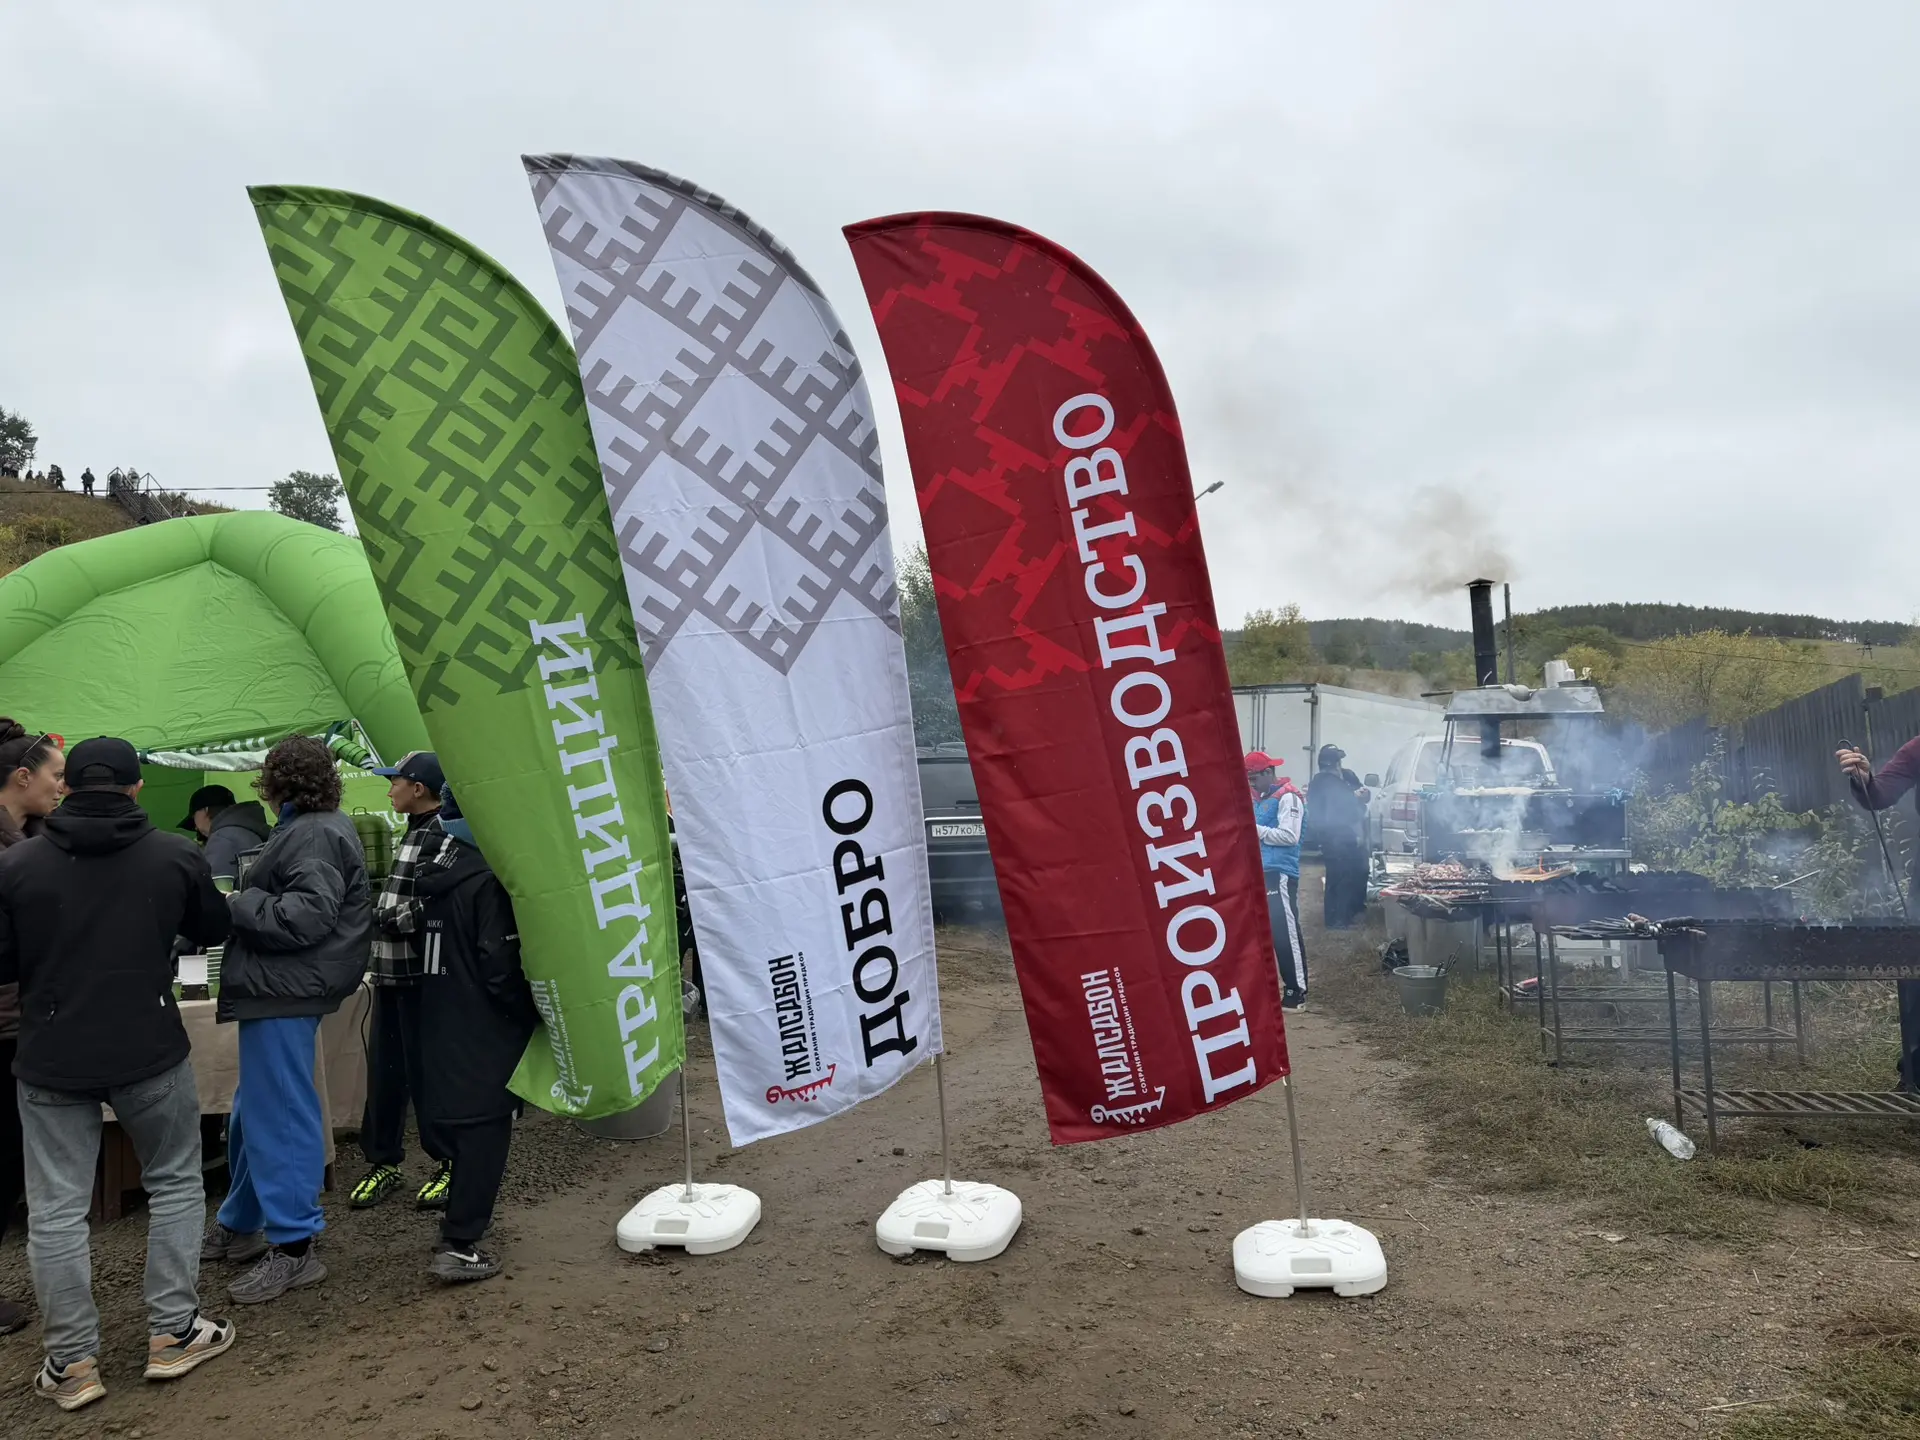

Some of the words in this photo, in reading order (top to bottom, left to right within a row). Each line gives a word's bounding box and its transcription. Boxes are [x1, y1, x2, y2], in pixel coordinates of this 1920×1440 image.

[1053, 393, 1257, 1104] ПРОИЗВОДСТВО
[529, 612, 660, 1098] ТРАДИЦИИ
[822, 778, 917, 1067] ДОБРО
[798, 951, 809, 987] ПРЕДКОВ
[1113, 966, 1127, 1005] ПРЕДКОВ
[768, 954, 811, 1081] ЖАЛСАБОН
[804, 988, 816, 1030] ТРАДИЦИИ
[1123, 1006, 1137, 1050] ТРАДИЦИИ
[811, 1031, 822, 1072] СОХРАНЯЯ
[1080, 969, 1137, 1101] ЖАЛСАБОН
[1132, 1051, 1148, 1094] СОХРАНЯЯ
